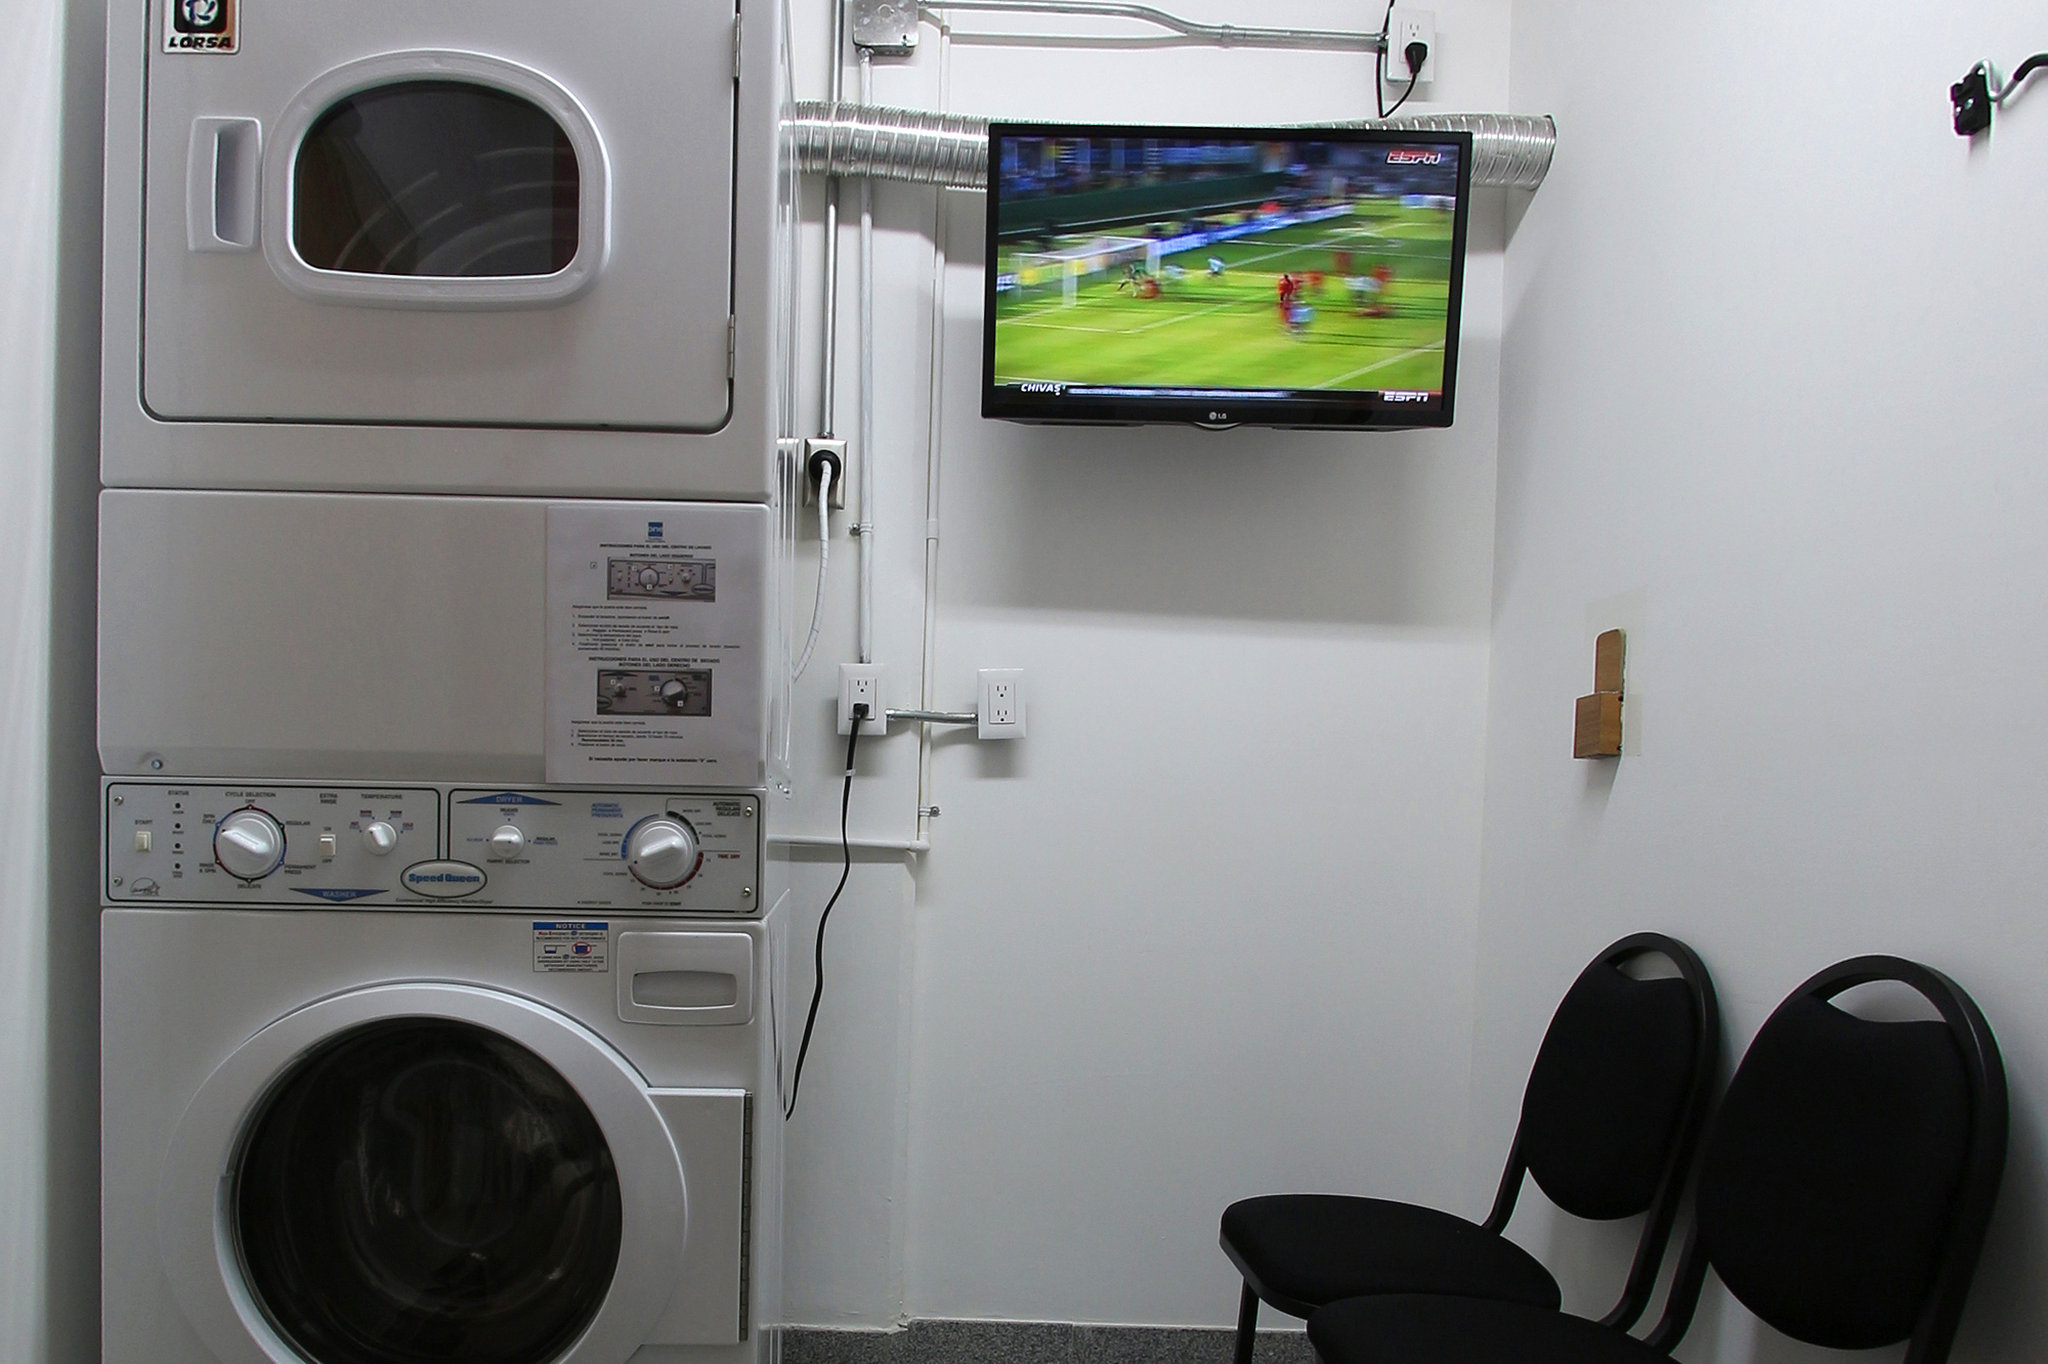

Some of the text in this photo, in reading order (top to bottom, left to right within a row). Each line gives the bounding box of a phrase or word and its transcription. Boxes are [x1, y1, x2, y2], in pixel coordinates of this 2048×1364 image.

[169, 36, 231, 48] LORSA
[1386, 151, 1442, 165] ESPN
[1020, 383, 1062, 394] CHIVAS
[1383, 391, 1429, 402] ESPN
[495, 795, 523, 803] DRYER
[408, 872, 480, 884] Speed Queen
[322, 890, 357, 898] WASHER
